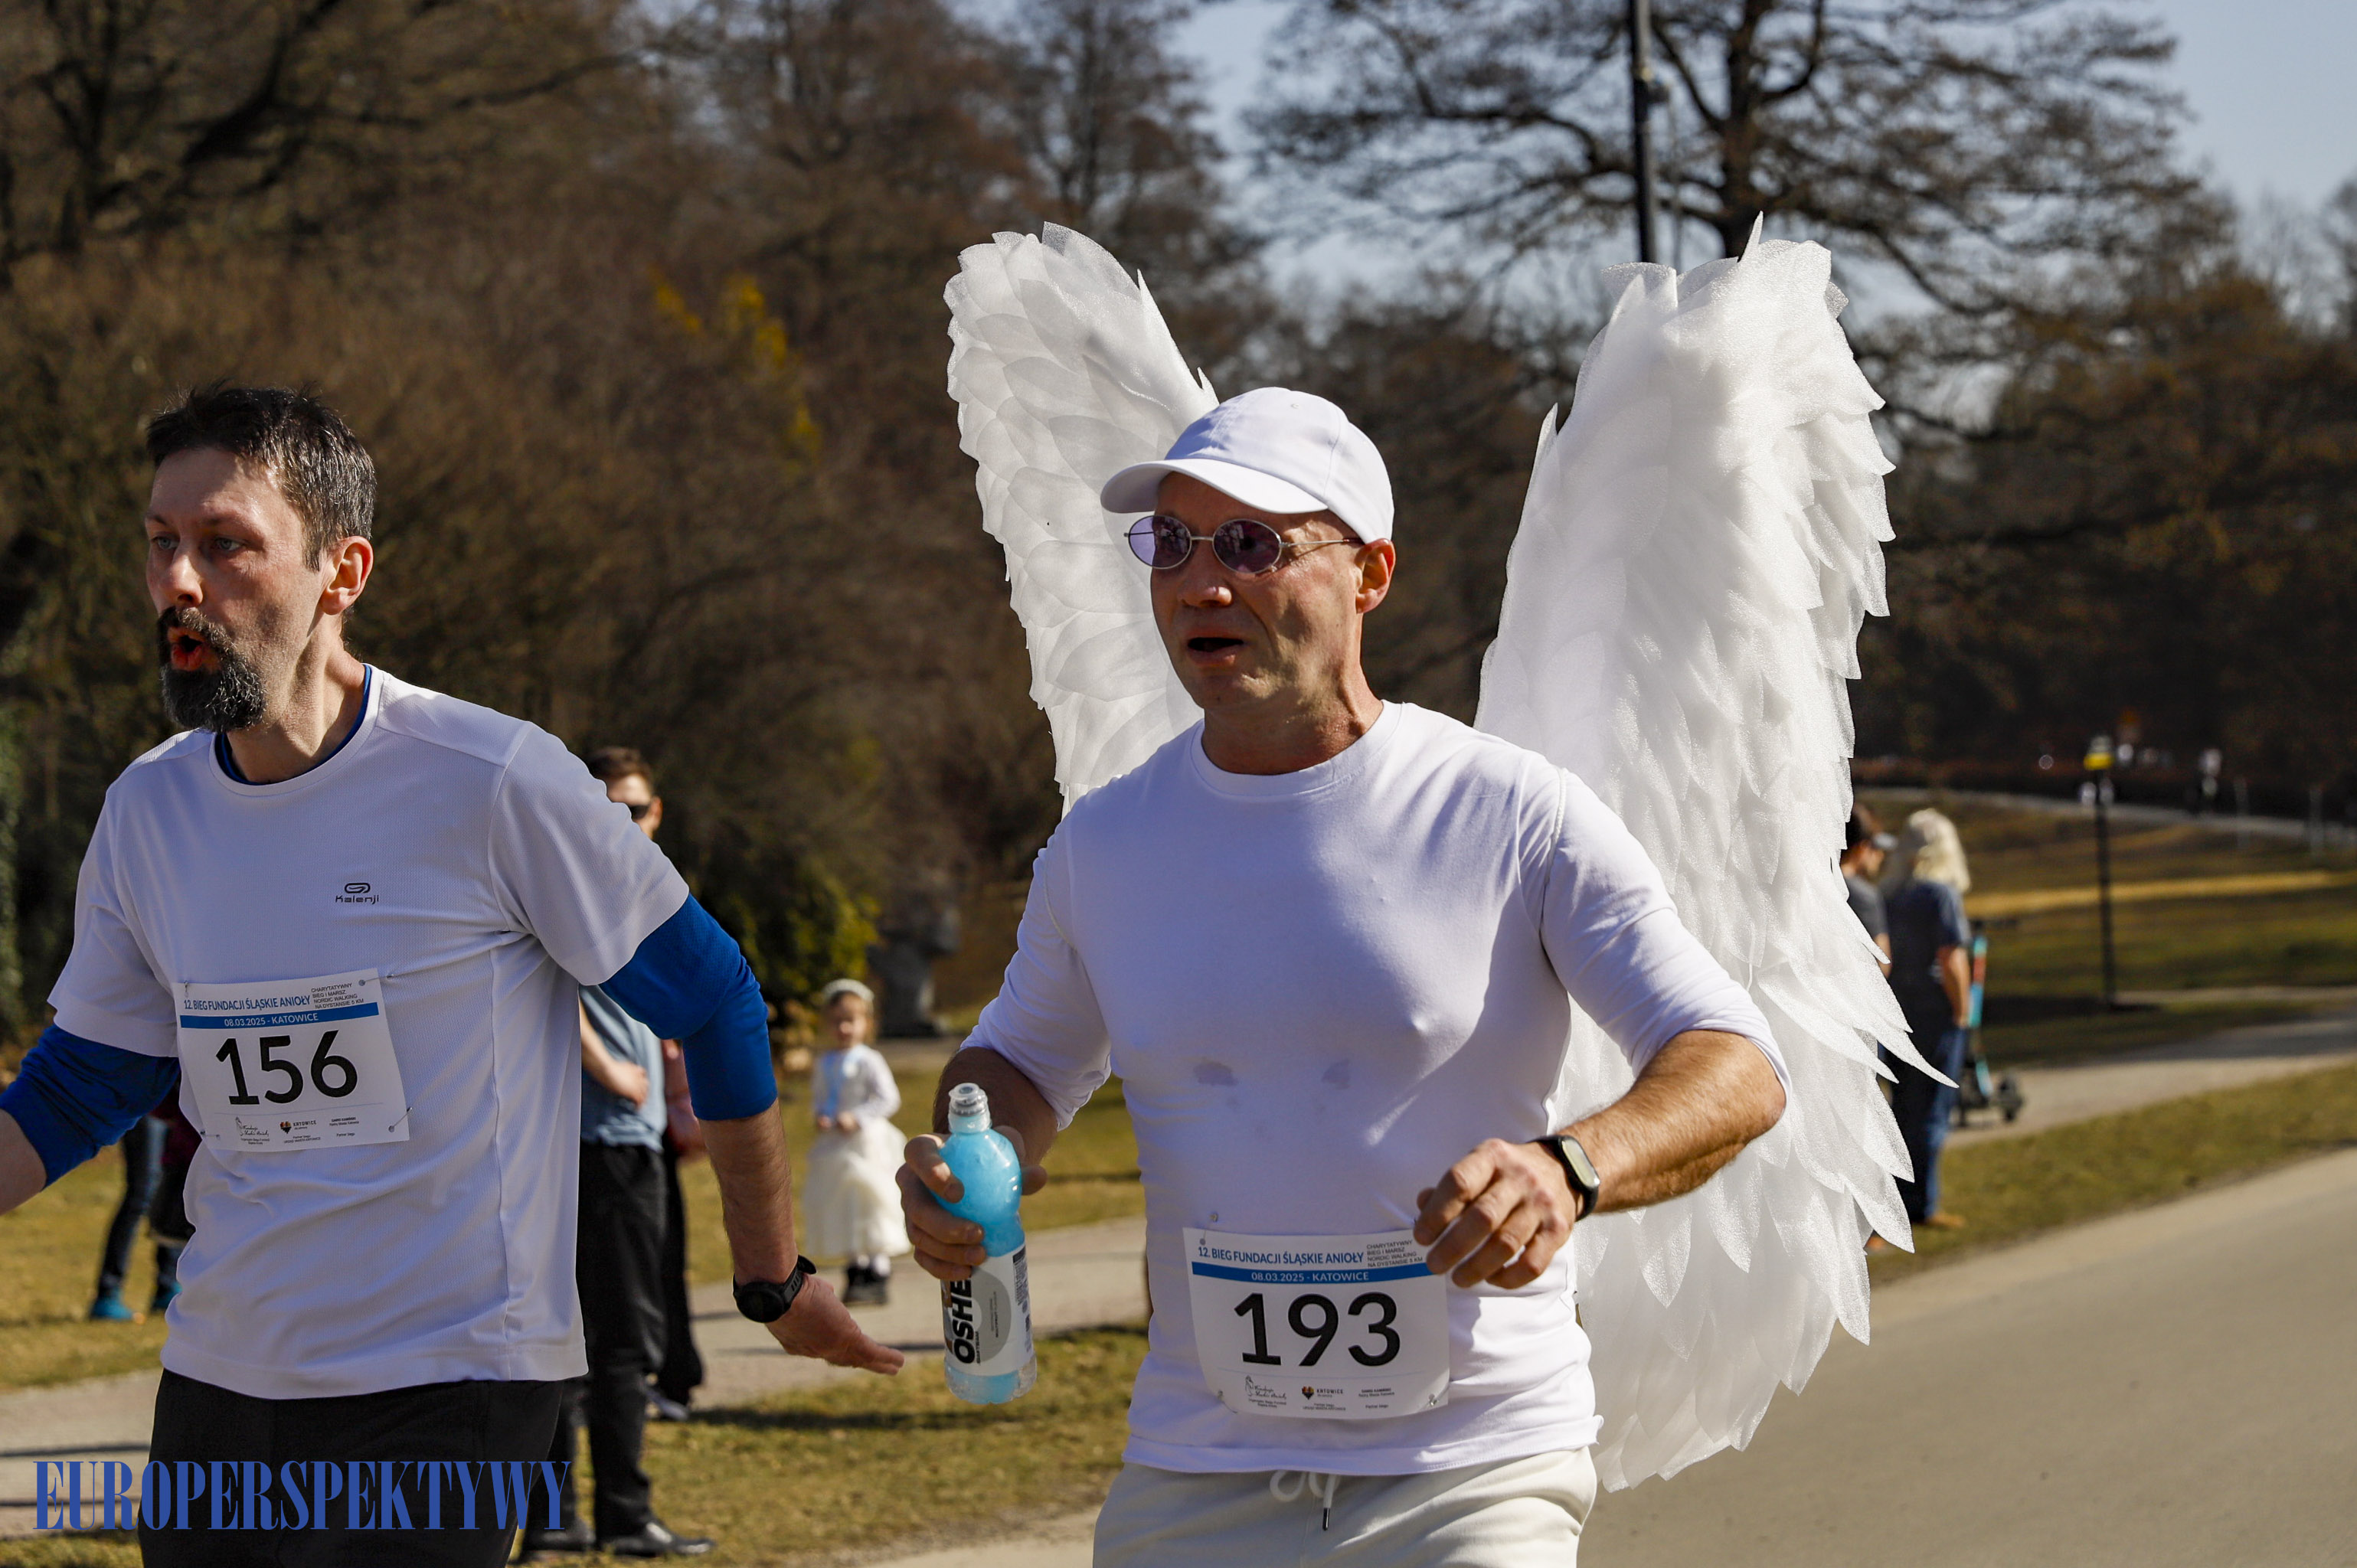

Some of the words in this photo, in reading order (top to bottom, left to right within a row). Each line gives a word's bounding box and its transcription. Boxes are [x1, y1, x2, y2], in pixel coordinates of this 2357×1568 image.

[335, 894, 379, 905] Kalenji
[311, 982, 352, 993] CHARYTATYWNY
[193, 1000, 208, 1011] BIEG
[208, 1000, 245, 1011] FUNDACJI
[246, 997, 279, 1011] ŚLĄSKIE
[280, 995, 311, 1008] ANIOŁY
[224, 1017, 266, 1027] 08.03.2025
[271, 1012, 319, 1024] KATOWICE
[216, 1030, 358, 1105] 156
[1198, 1246, 1211, 1258] 12.
[1211, 1250, 1232, 1261] BIEG
[1233, 1251, 1281, 1264] FUNDACJI
[1283, 1250, 1324, 1266] ŚLĄSKIE
[1325, 1252, 1365, 1263] ANIOŁY
[1251, 1272, 1304, 1282] 08.03.2025
[1313, 1272, 1369, 1282] KATOWICE
[950, 1279, 976, 1364] OSHE
[1234, 1292, 1401, 1367] 193
